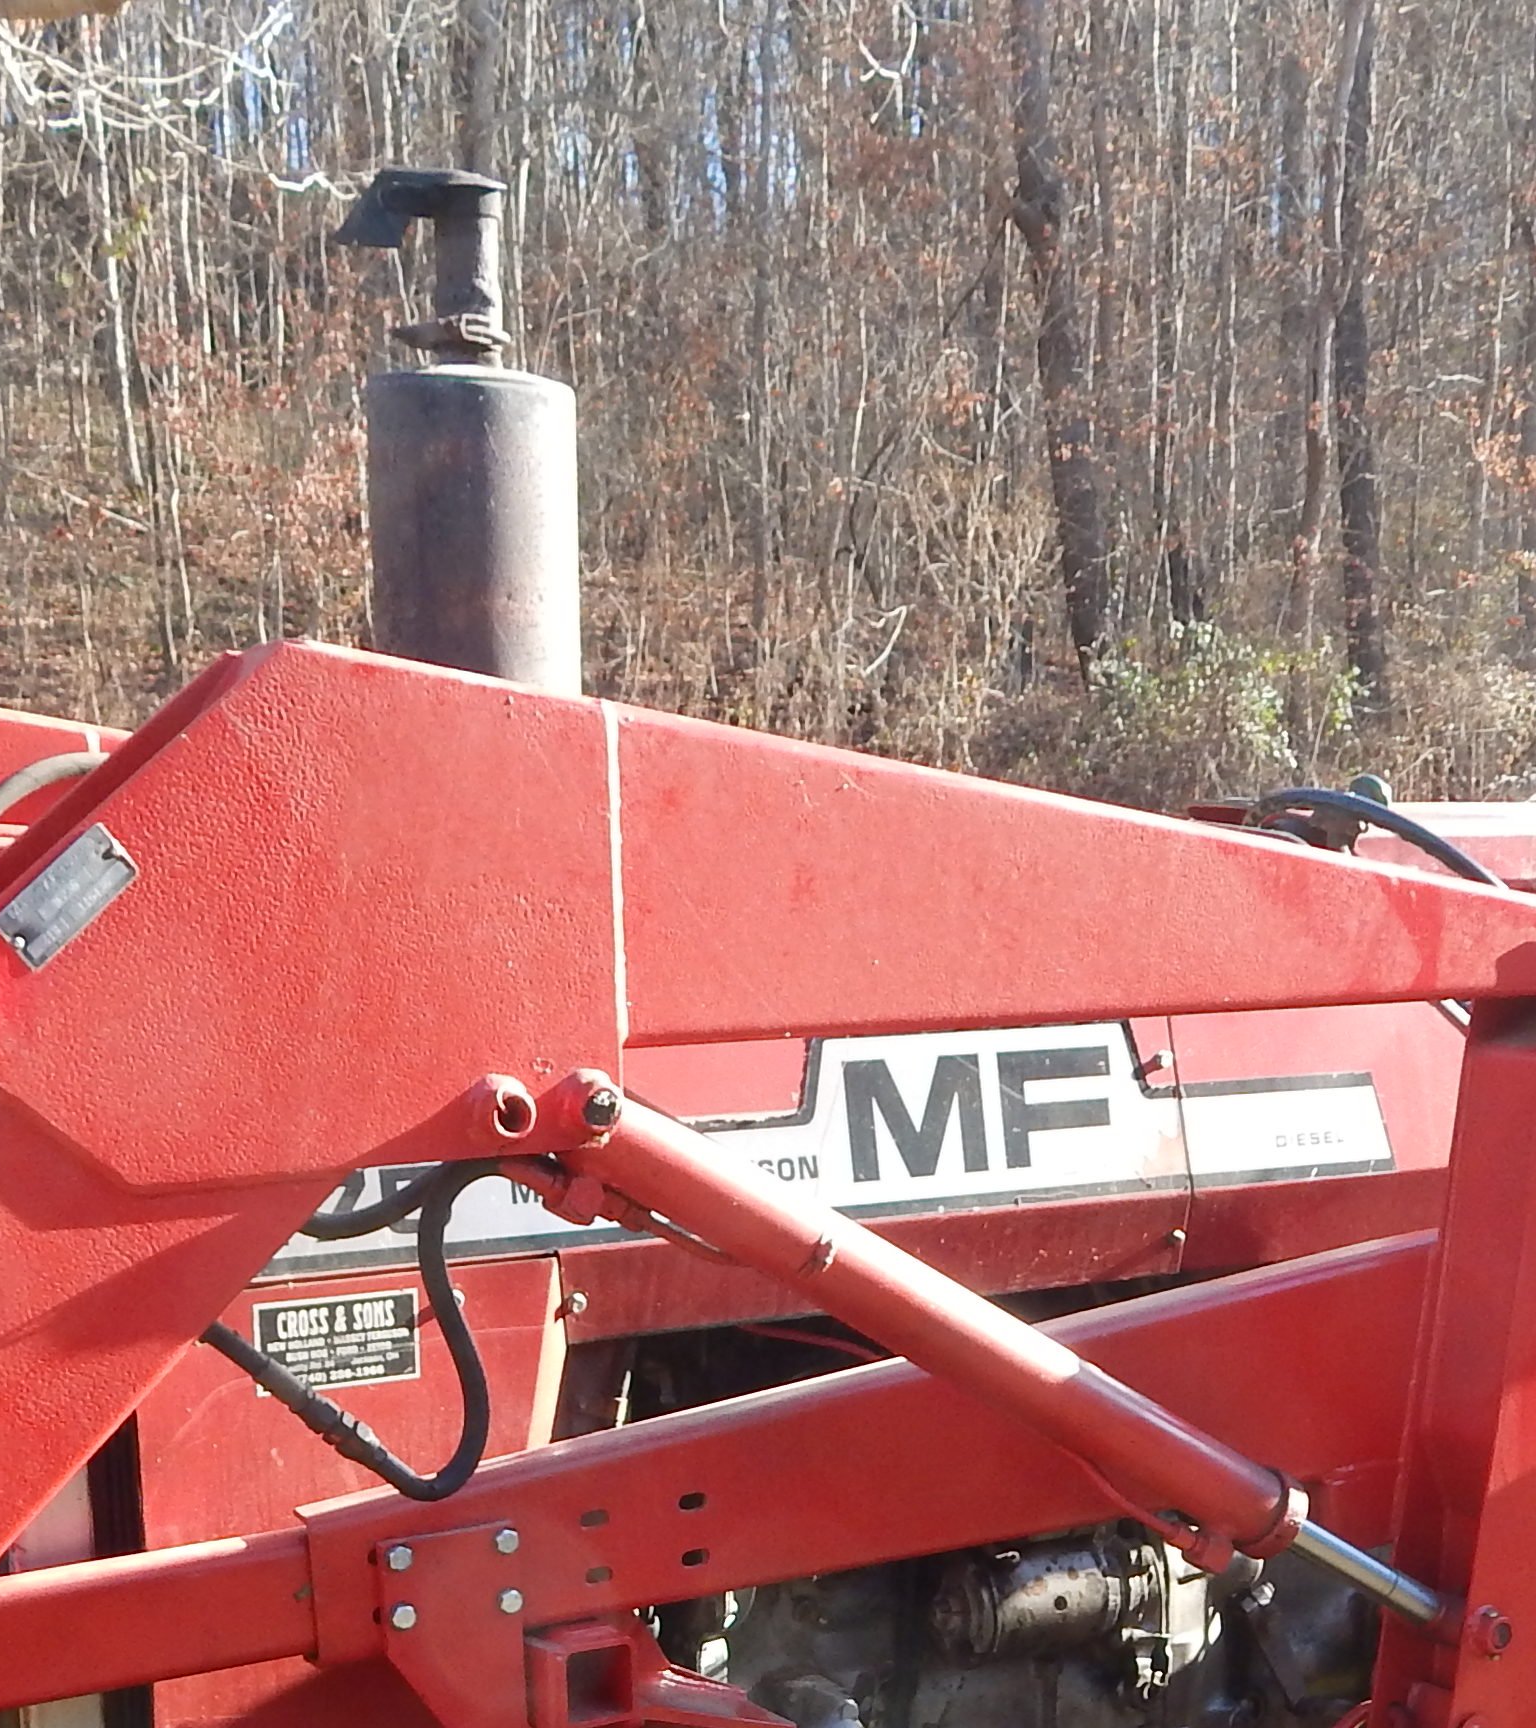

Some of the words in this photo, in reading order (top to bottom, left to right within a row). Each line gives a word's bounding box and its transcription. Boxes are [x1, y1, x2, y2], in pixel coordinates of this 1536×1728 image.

[842, 1045, 1111, 1184] MF
[276, 1306, 330, 1340] CROSS
[333, 1304, 348, 1333] &
[352, 1299, 396, 1331] SONS
